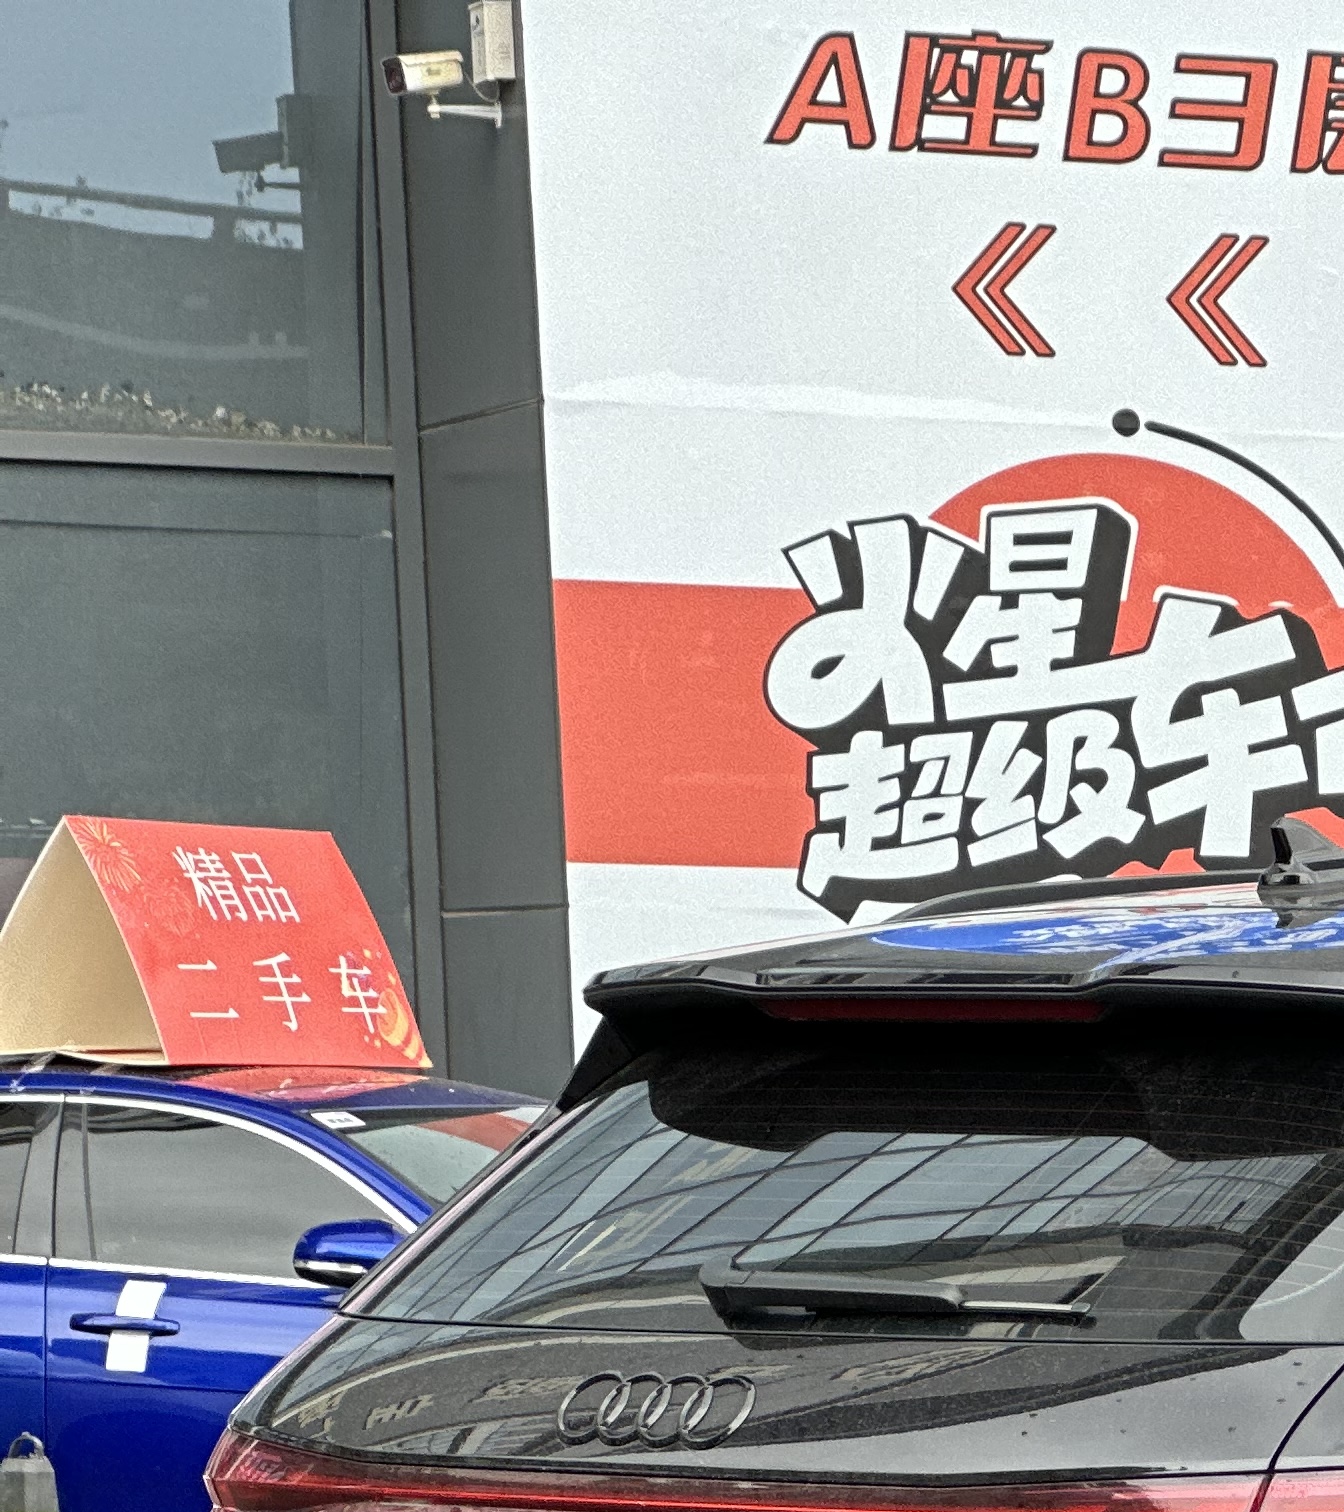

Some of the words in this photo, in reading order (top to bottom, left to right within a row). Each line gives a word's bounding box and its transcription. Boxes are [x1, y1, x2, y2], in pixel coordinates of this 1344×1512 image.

[172, 845, 301, 923] 精品
[177, 951, 387, 1034] 二手车
